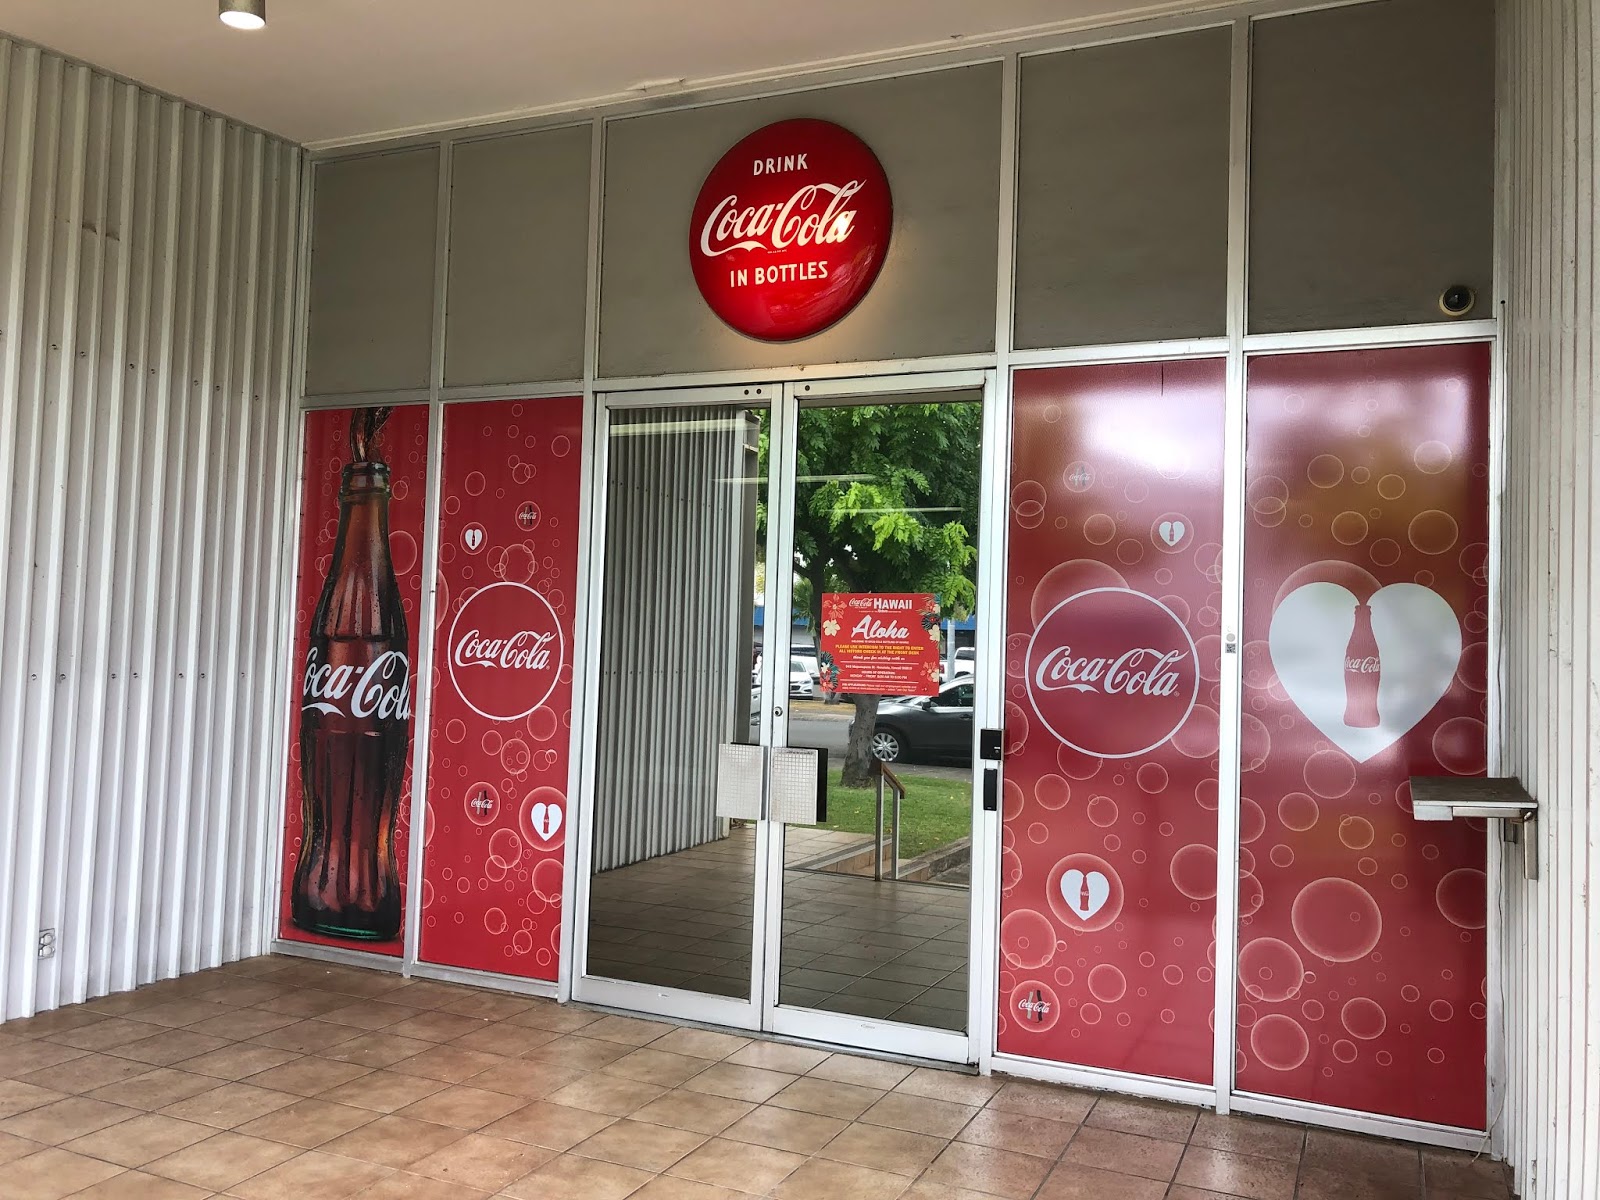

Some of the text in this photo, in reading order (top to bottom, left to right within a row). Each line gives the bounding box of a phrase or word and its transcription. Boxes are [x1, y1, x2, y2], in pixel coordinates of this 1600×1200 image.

[753, 153, 808, 176] DRINK
[700, 179, 867, 257] Coca-Cola
[730, 261, 828, 288] IN BOTTLES
[849, 598, 912, 610] Coca-Cola HAWAII
[851, 615, 909, 639] Aloha
[454, 629, 556, 670] Coca-Cola
[1036, 645, 1190, 698] Coca-Cola
[1018, 998, 1052, 1014] Coca-Cola
